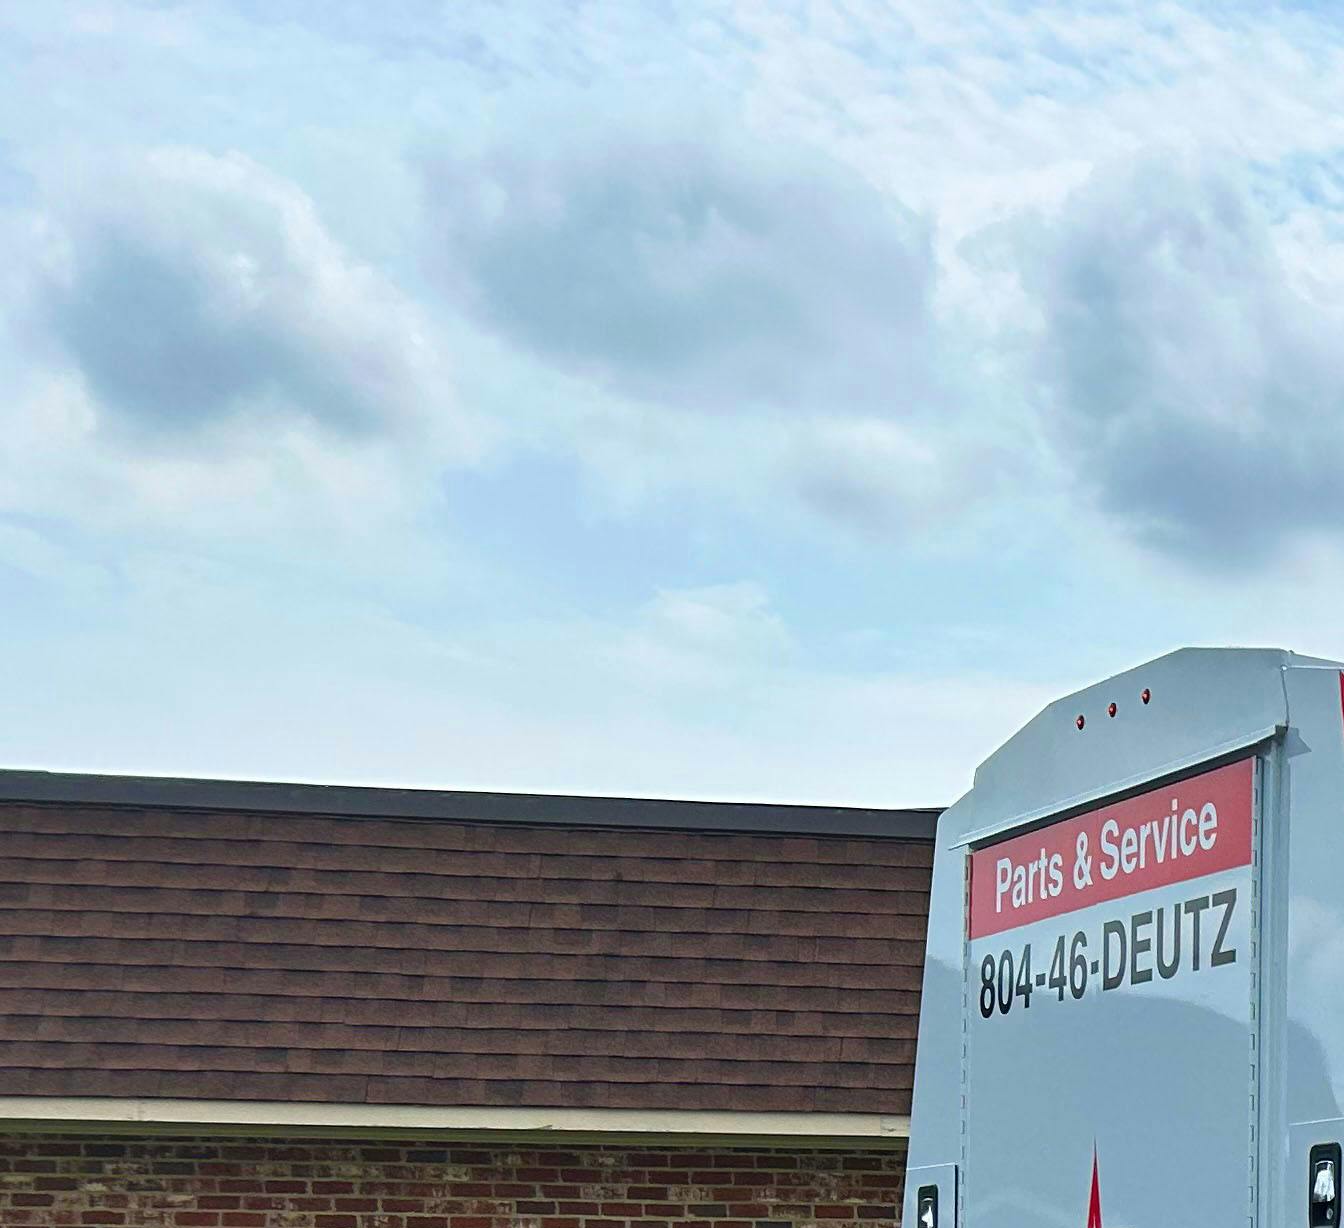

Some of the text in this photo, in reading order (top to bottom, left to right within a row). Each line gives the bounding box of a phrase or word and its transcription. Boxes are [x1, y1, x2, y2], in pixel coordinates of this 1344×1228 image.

[995, 799, 1218, 913] Parts & Service
[979, 887, 1238, 1020] 804-46-DEUTZ
